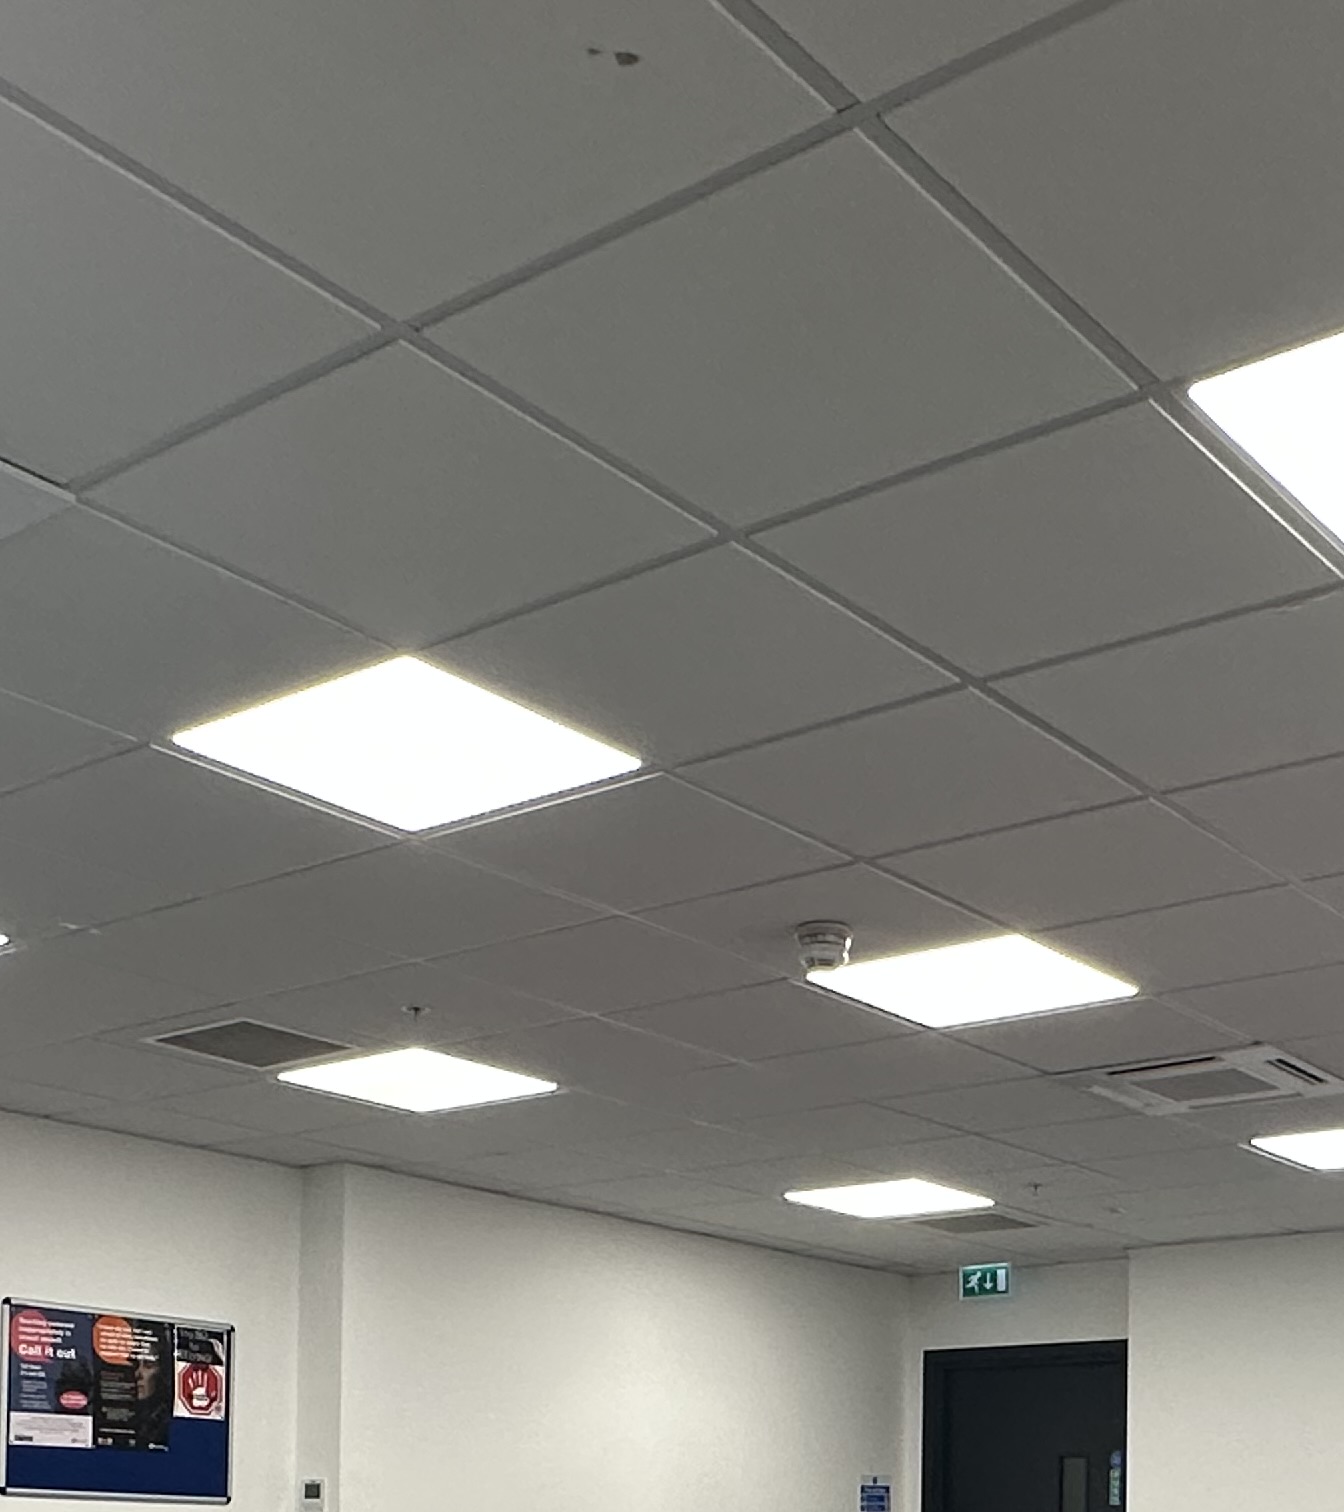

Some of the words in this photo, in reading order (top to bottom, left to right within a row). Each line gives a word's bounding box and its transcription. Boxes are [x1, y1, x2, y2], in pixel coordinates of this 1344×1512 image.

[18, 1344, 42, 1356] Call
[44, 1345, 54, 1358] it
[56, 1347, 76, 1360] out
